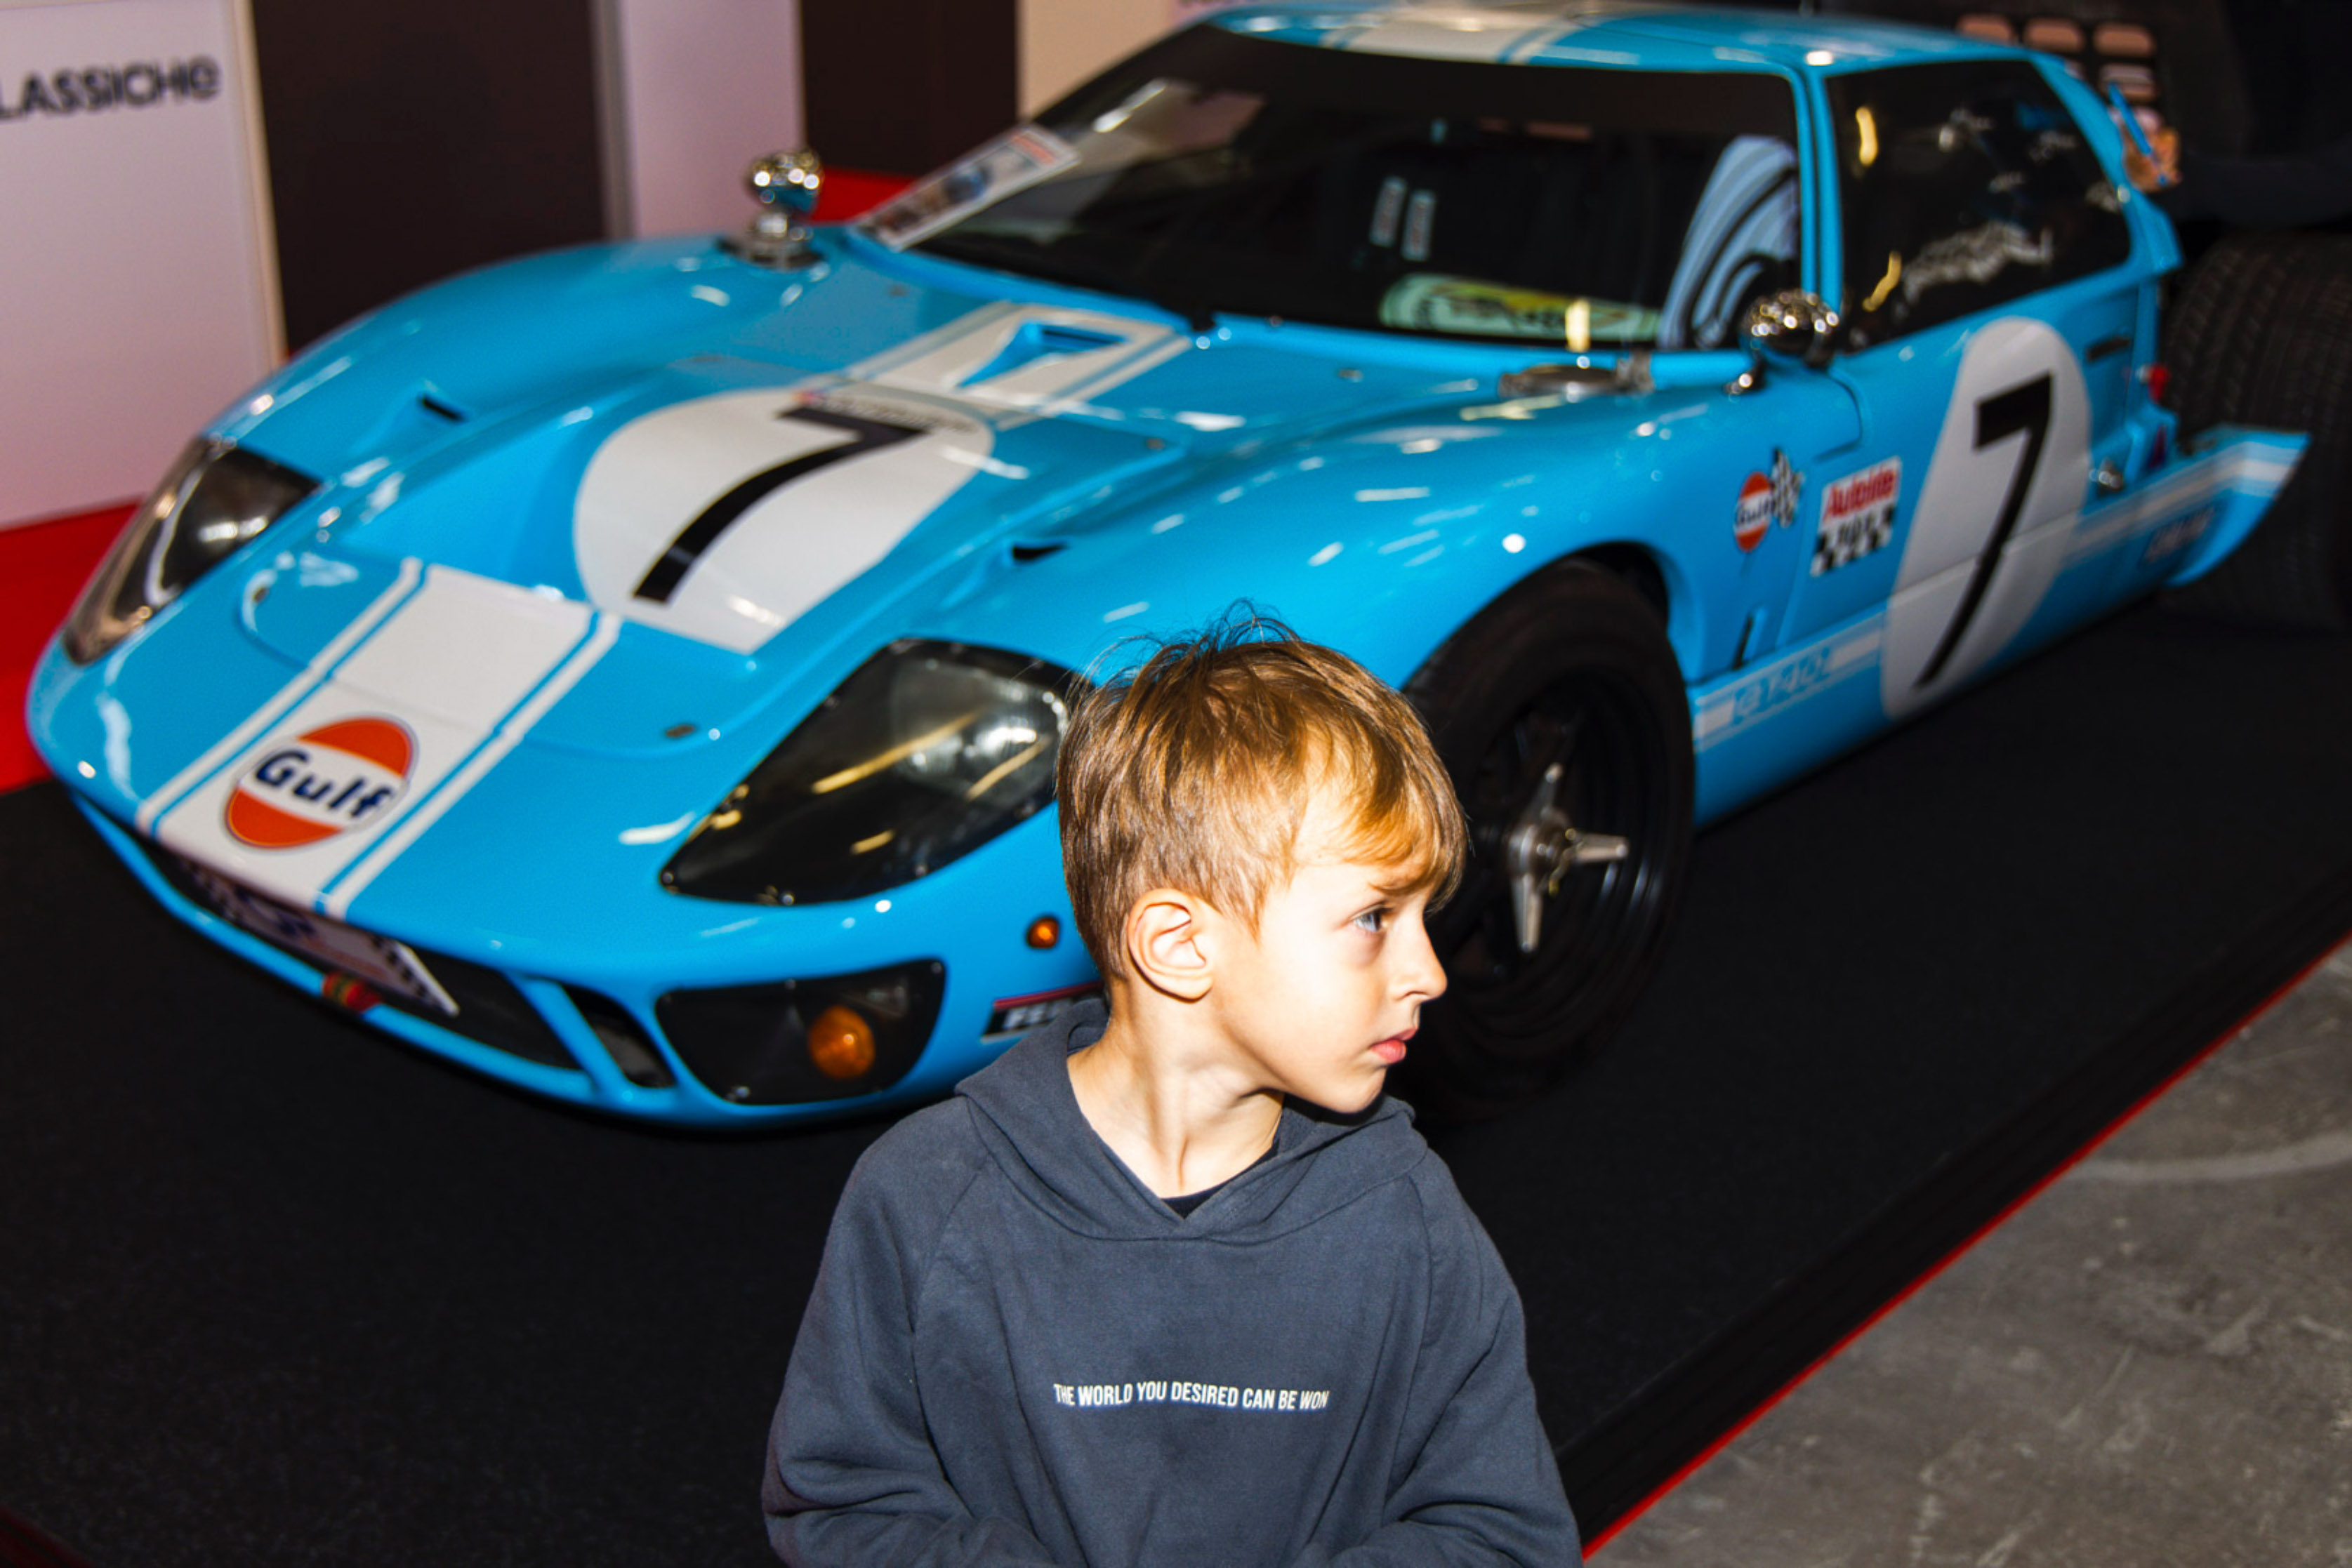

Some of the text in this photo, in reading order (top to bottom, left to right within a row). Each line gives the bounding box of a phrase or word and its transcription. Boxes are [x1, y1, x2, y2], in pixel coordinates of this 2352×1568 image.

[633, 406, 928, 604] 7
[1911, 373, 2053, 686] 7
[255, 749, 392, 818] Gulf
[1054, 1381, 1329, 1410] THE WORLD YOU DESIRED CAN BE WON
